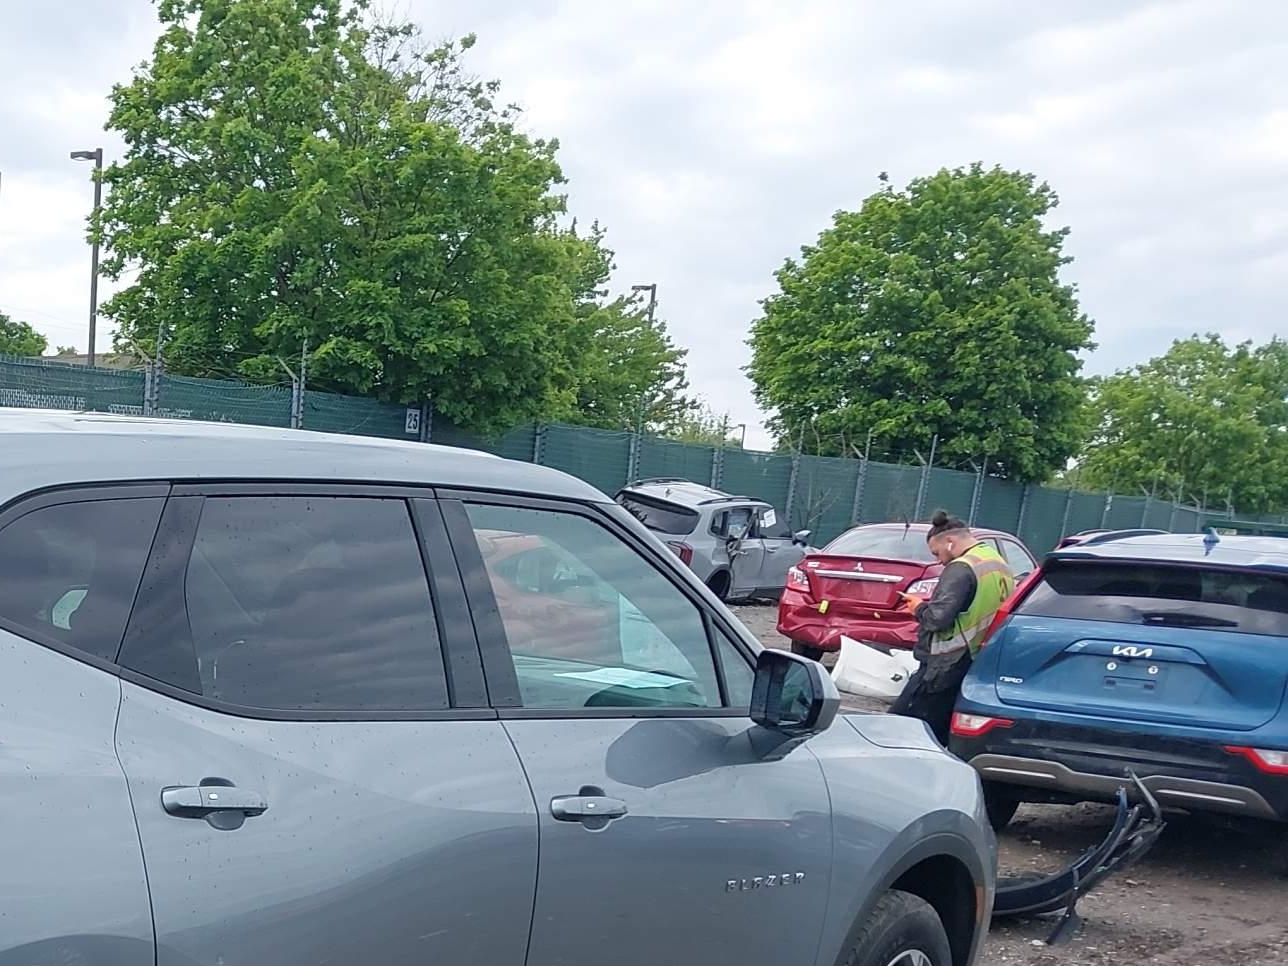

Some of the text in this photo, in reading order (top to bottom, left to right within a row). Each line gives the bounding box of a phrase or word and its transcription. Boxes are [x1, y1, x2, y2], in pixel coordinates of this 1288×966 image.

[407, 413, 418, 430] 25
[1112, 646, 1153, 658] KIA
[724, 871, 807, 893] BLAZER
